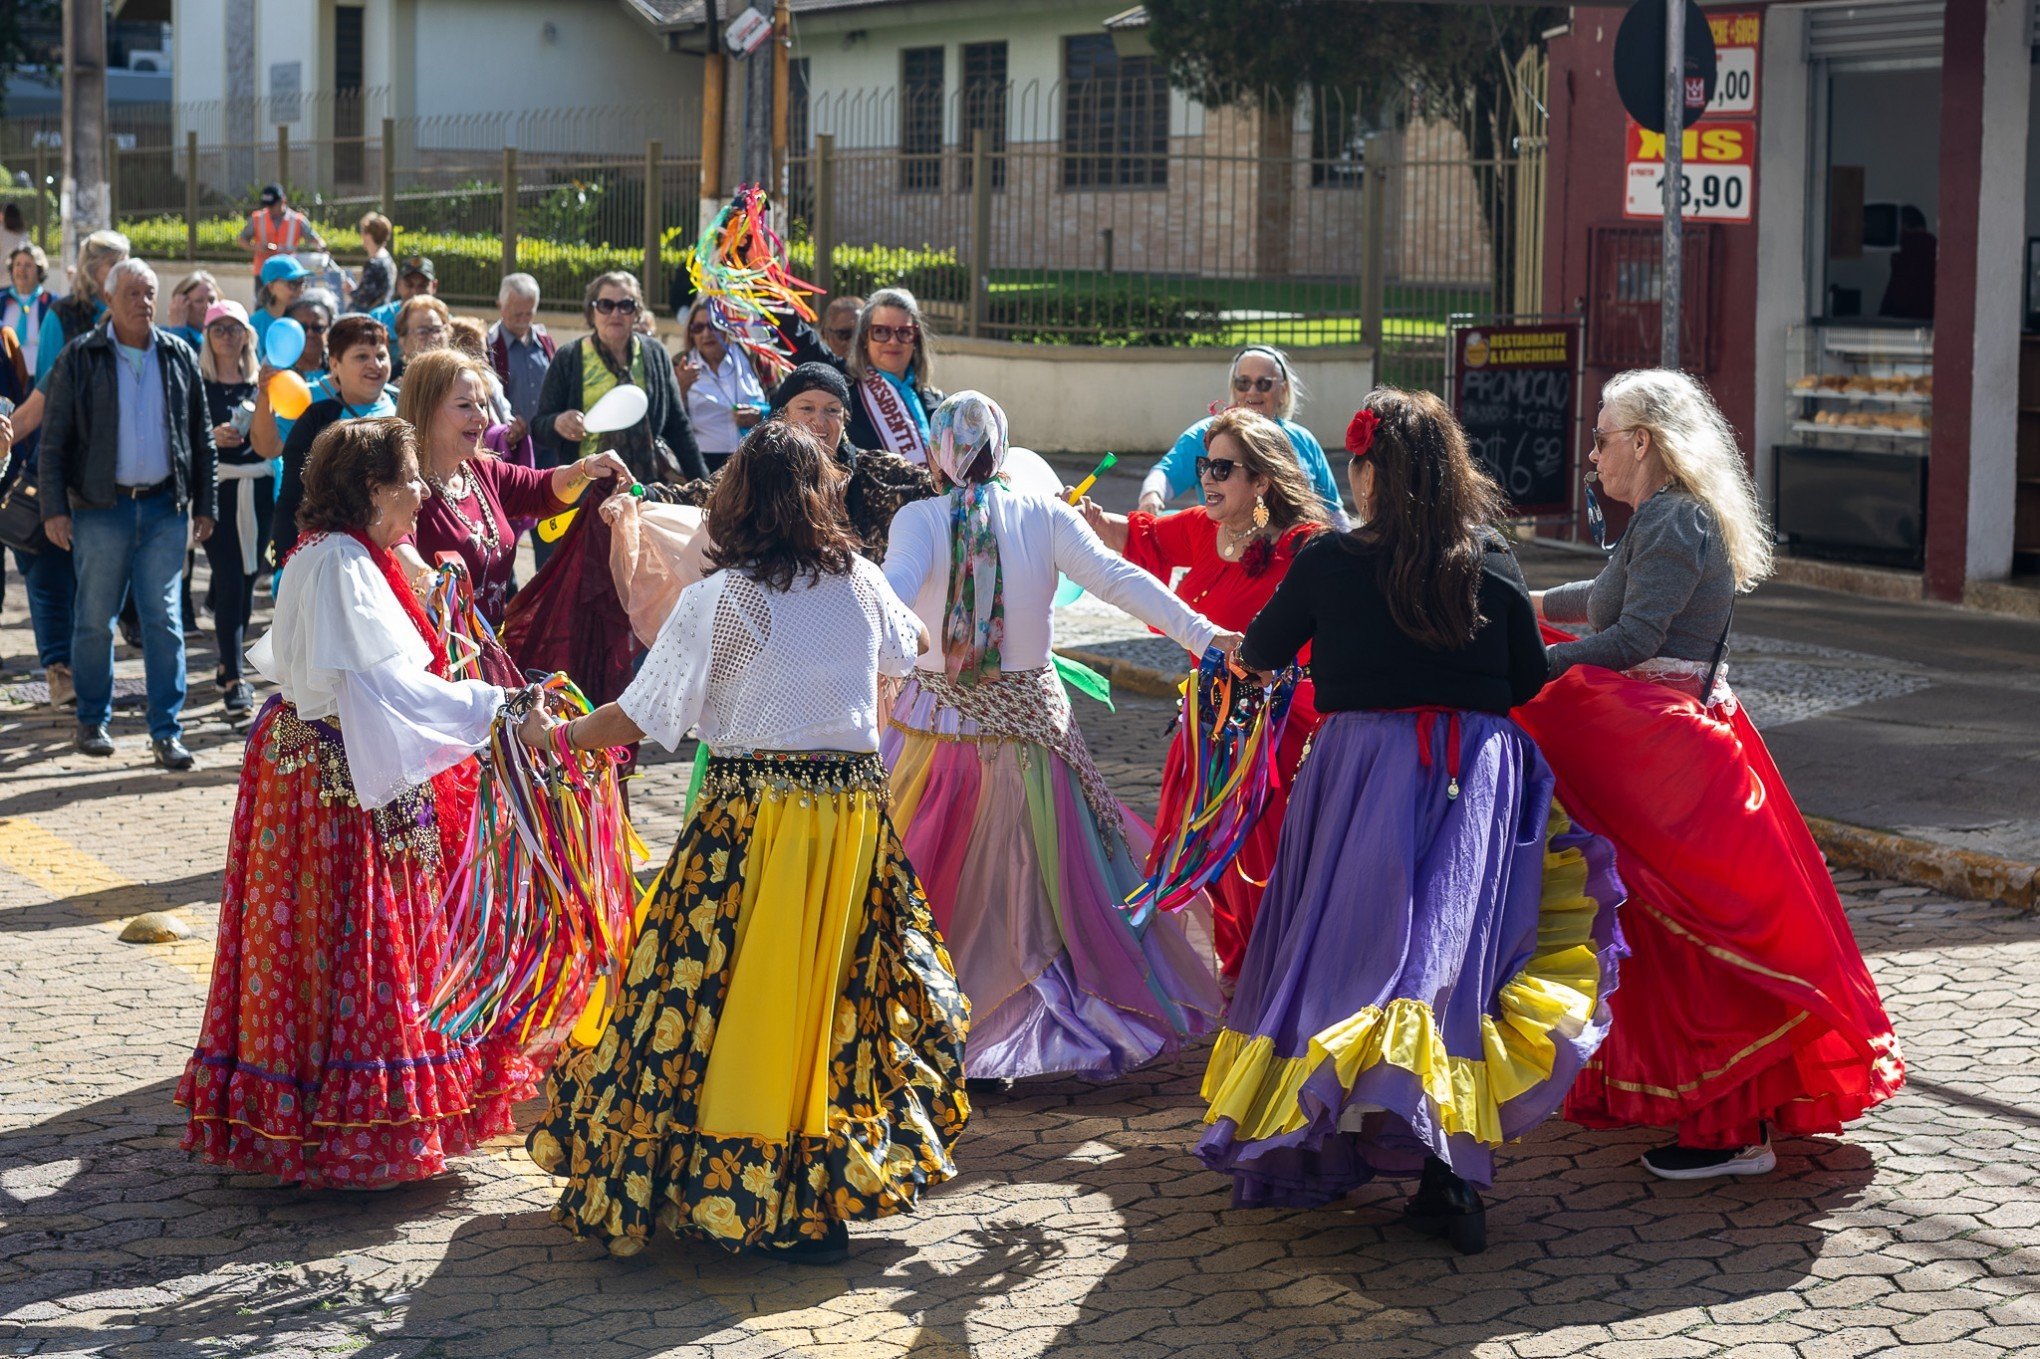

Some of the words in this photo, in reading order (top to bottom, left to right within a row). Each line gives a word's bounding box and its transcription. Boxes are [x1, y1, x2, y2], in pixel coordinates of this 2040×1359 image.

[1637, 129, 1743, 161] XIS
[1489, 332, 1566, 349] RESTAURANTE
[1489, 350, 1498, 364] &
[1500, 348, 1567, 364] LANCHERIA
[866, 368, 917, 455] PRESIDENTE
